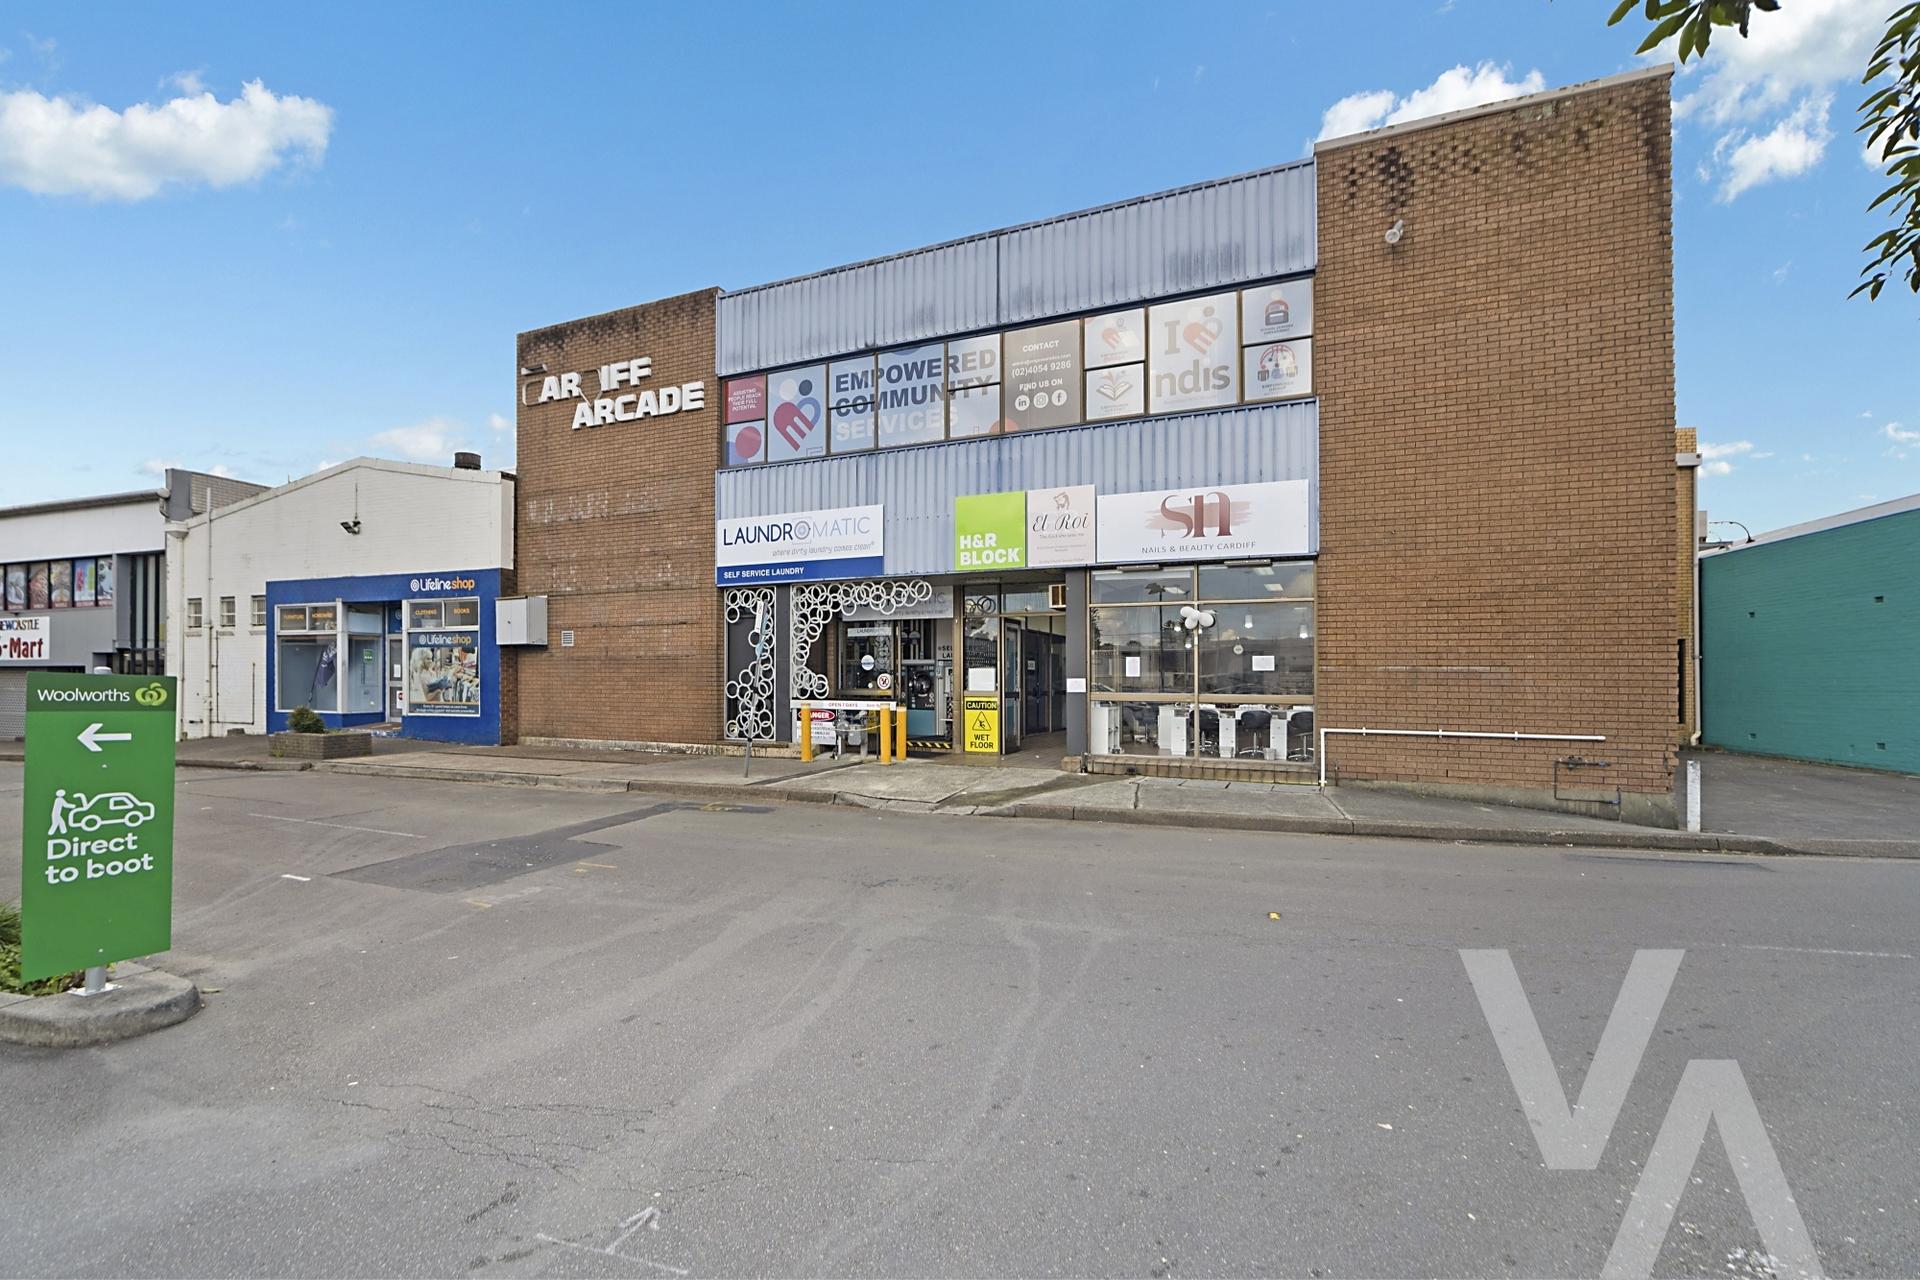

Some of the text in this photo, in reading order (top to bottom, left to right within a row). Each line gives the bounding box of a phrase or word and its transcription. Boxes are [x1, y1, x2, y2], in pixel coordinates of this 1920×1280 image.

[1022, 340, 1060, 353] CONTACT
[835, 349, 997, 393] EMPOWERED
[1155, 359, 1231, 397] ndis
[1019, 382, 1037, 391] FIND
[1051, 378, 1063, 386] ON
[835, 374, 994, 417] COMMUNITY
[572, 380, 705, 430] ARCADE
[1055, 512, 1088, 531] Roi
[723, 516, 871, 546] LAUNDROMATIC
[959, 533, 997, 549] H&R
[1142, 545, 1167, 554] NAILS
[1179, 543, 1214, 552] BEAUTY
[1217, 541, 1256, 550] CARDIFF
[808, 546, 832, 554] laundry
[960, 547, 1020, 566] BLOCK
[723, 567, 804, 579] SELF SERVICE LAUNDRY
[37, 688, 130, 702] Woolworths
[966, 702, 997, 710] CAUTION
[970, 741, 994, 749] FLOOR
[47, 833, 138, 860] Direct
[45, 853, 154, 884] to boot
